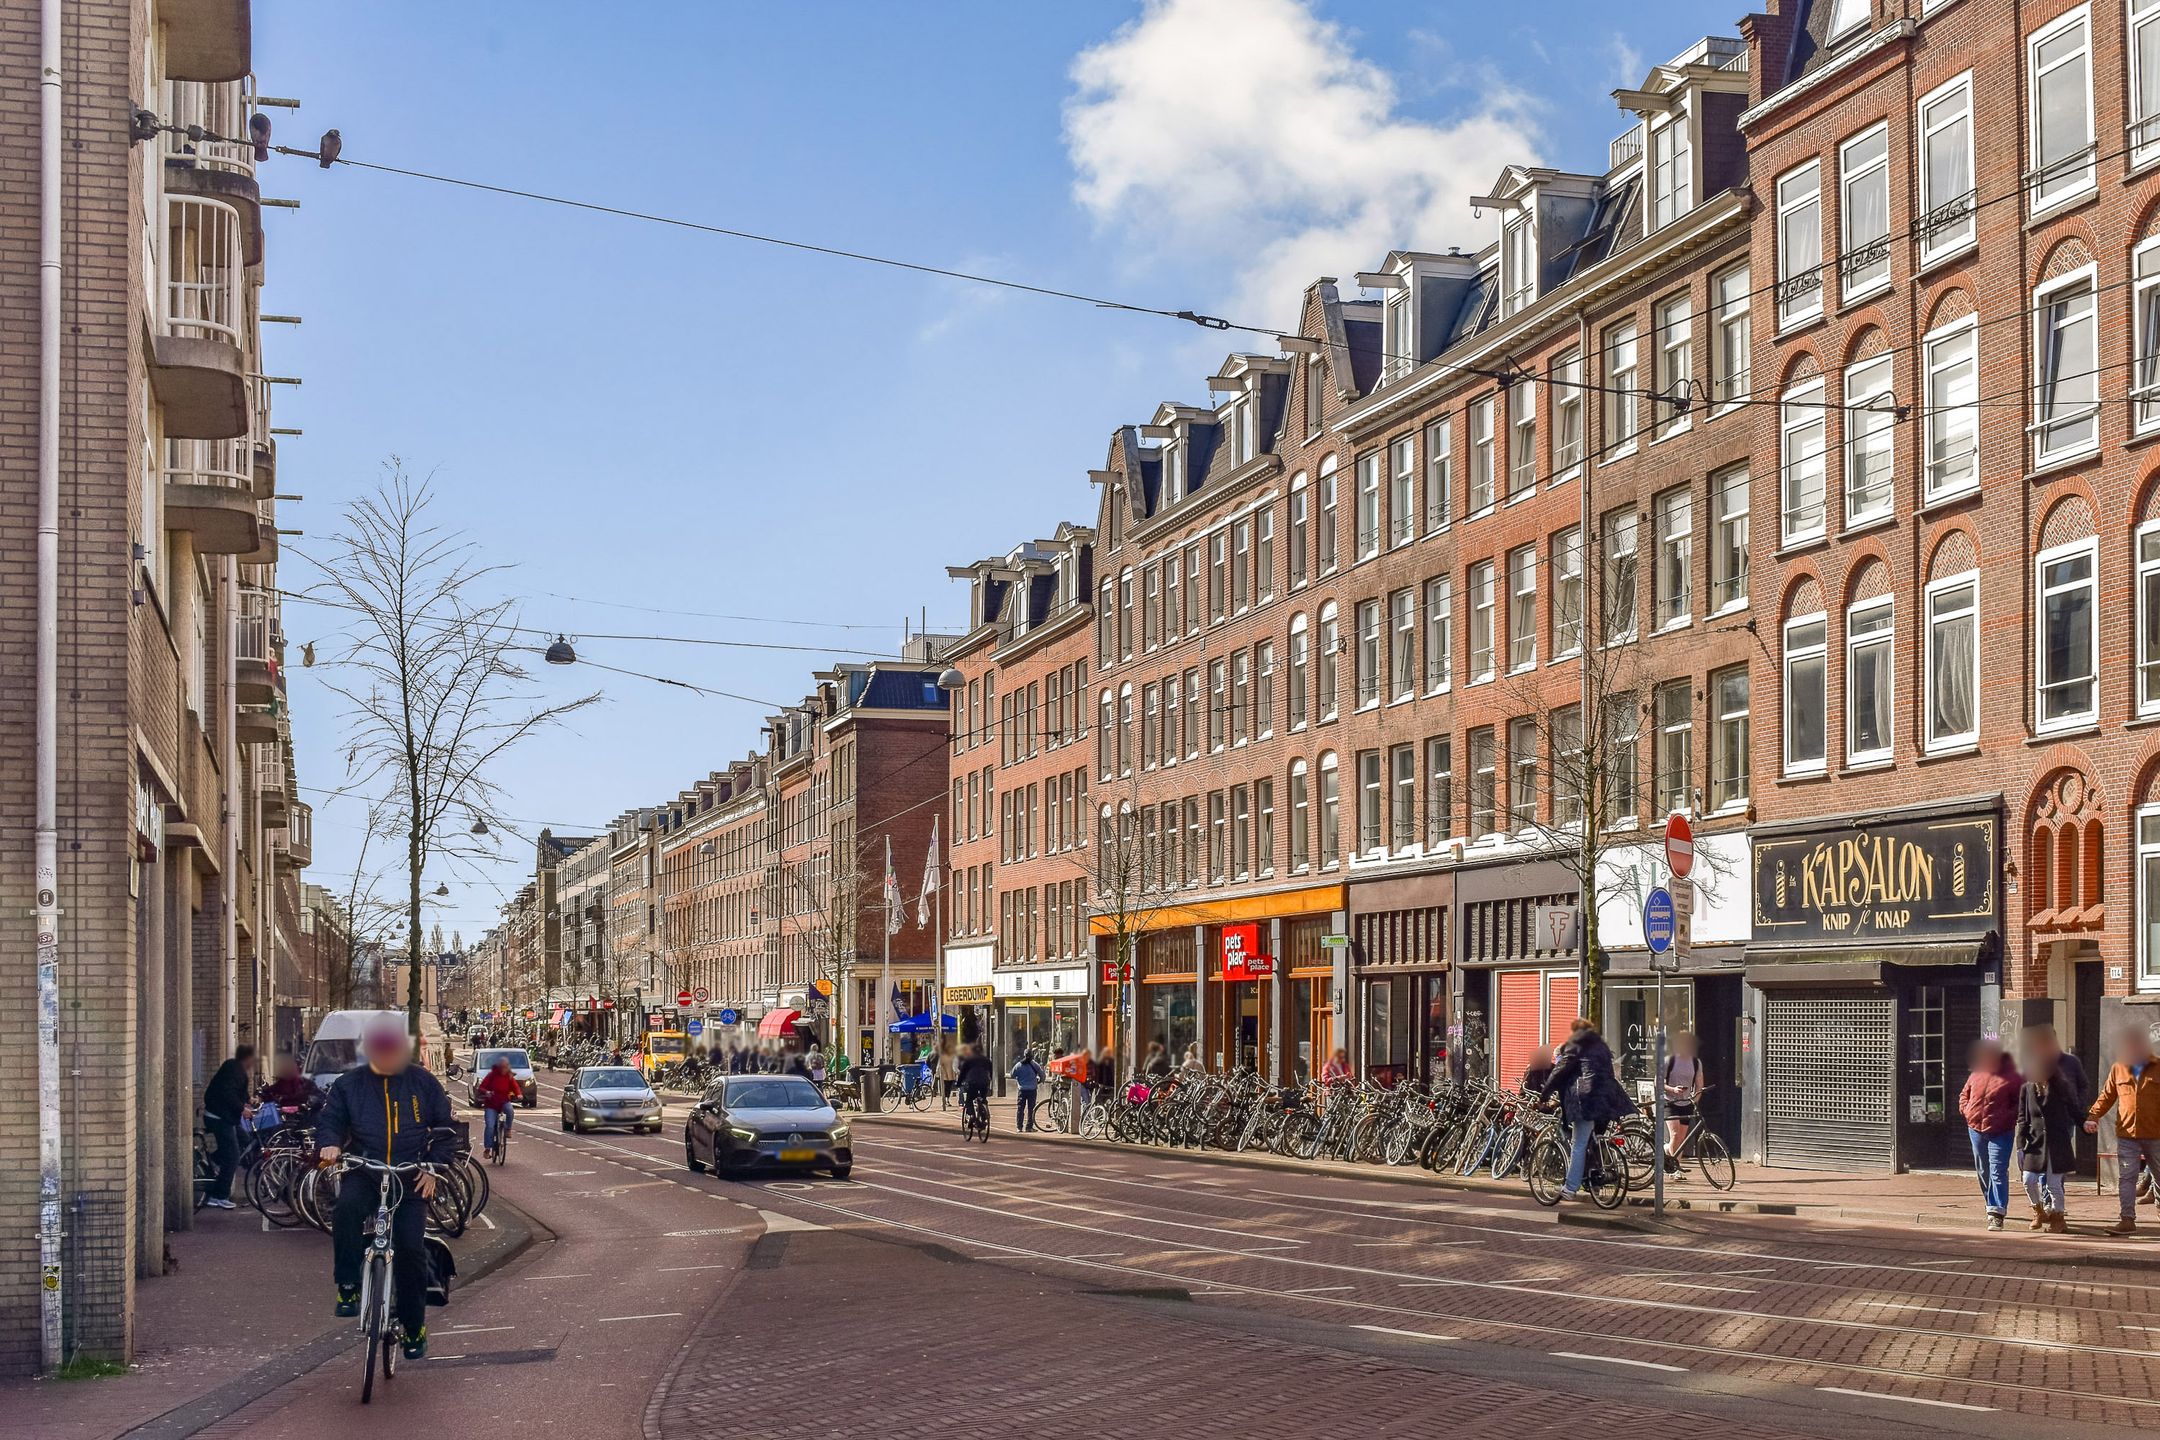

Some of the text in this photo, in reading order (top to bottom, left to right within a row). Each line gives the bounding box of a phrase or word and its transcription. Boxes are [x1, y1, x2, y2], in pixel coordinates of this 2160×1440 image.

[1802, 833, 1934, 913] KAPSALON
[1823, 905, 1910, 935] KNIP je KNAP
[1225, 933, 1241, 954] pets
[1228, 950, 1246, 970] plac
[1250, 964, 1269, 972] place
[696, 991, 706, 999] 30
[946, 988, 988, 1002] LEGERDUMP
